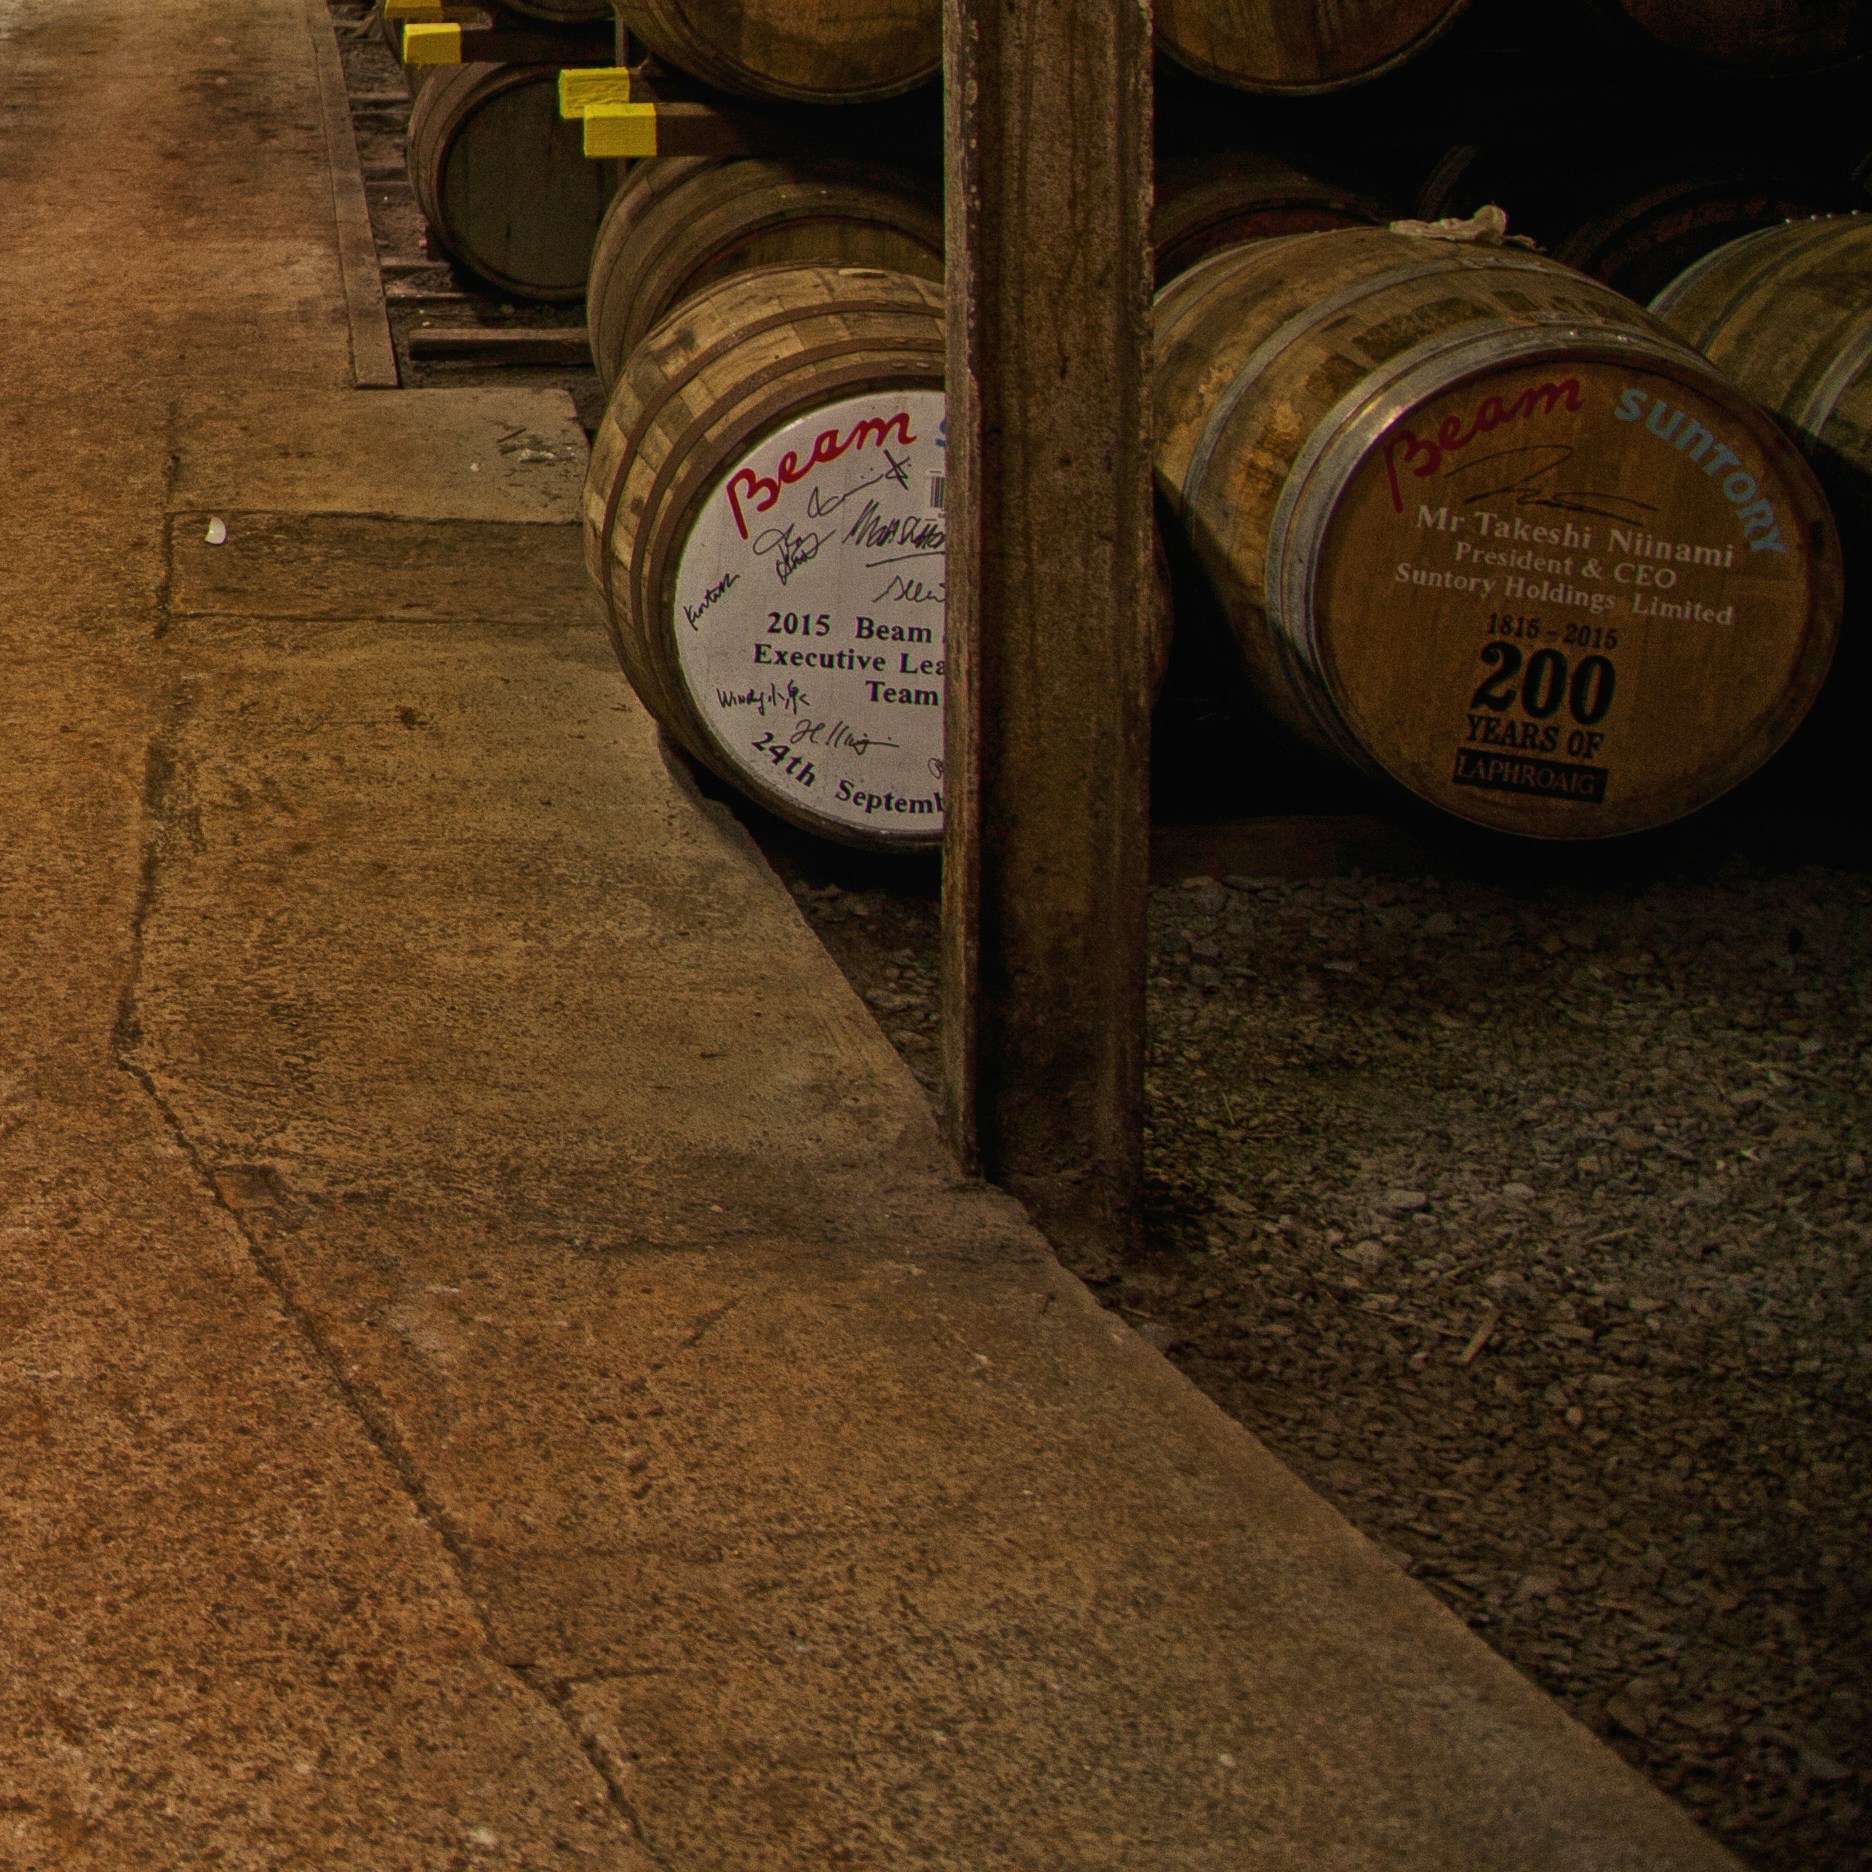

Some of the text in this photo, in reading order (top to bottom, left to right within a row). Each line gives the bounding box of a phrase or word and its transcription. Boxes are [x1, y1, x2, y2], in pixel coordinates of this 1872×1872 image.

[1382, 378, 1583, 513] Beam
[725, 411, 918, 541] Beam
[1416, 504, 1735, 568] Mr Takeshi Niinami
[1455, 540, 1677, 589] President & CEO
[1394, 561, 1737, 626] Suntory Holdings Limited
[767, 611, 933, 644] 2015 Beam
[1487, 612, 1541, 640] 1815
[1563, 622, 1618, 651] 2015
[753, 642, 887, 672] Executive
[865, 680, 940, 706] Team
[1470, 640, 1617, 725] 200
[751, 731, 817, 788] 24th
[1465, 713, 1605, 759] YEARS OF
[1457, 753, 1597, 795] LAPHROAIG
